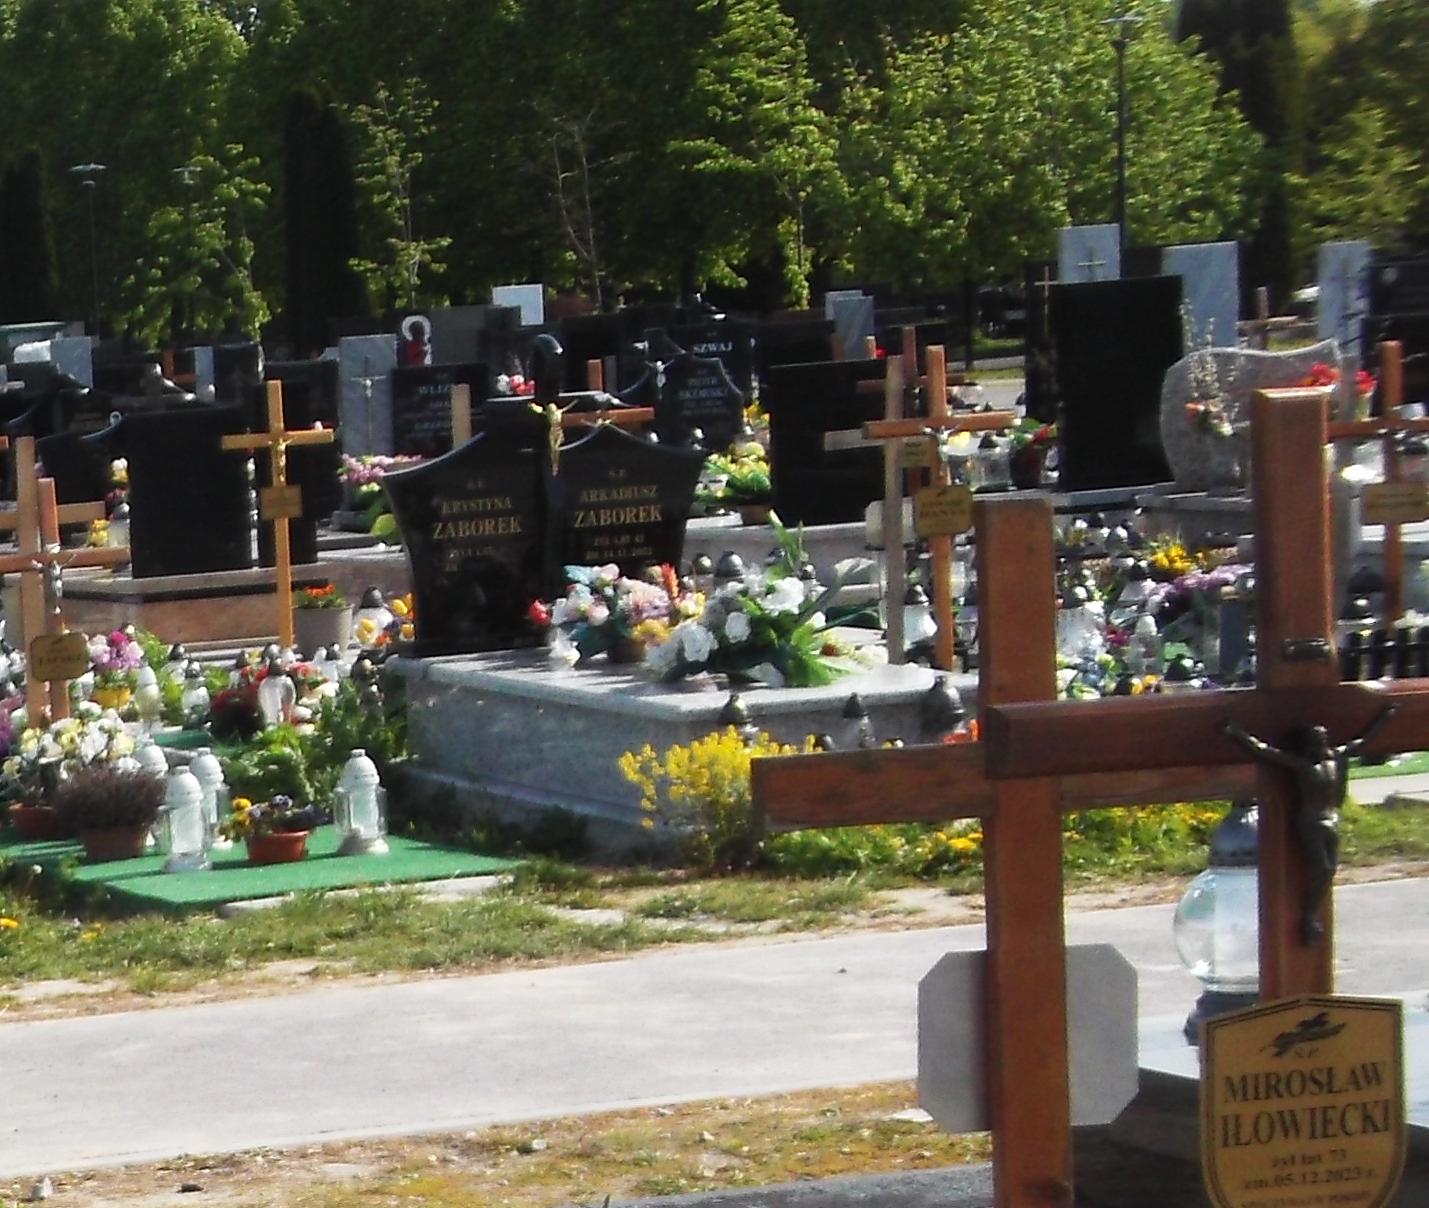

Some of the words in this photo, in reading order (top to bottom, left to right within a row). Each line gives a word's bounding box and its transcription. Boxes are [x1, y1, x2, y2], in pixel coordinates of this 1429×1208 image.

[442, 496, 512, 515] KRYSTYNA
[574, 504, 662, 529] ZABOREK
[432, 515, 522, 540] ZABOREK
[1223, 1059, 1388, 1103] MIROSŁAW
